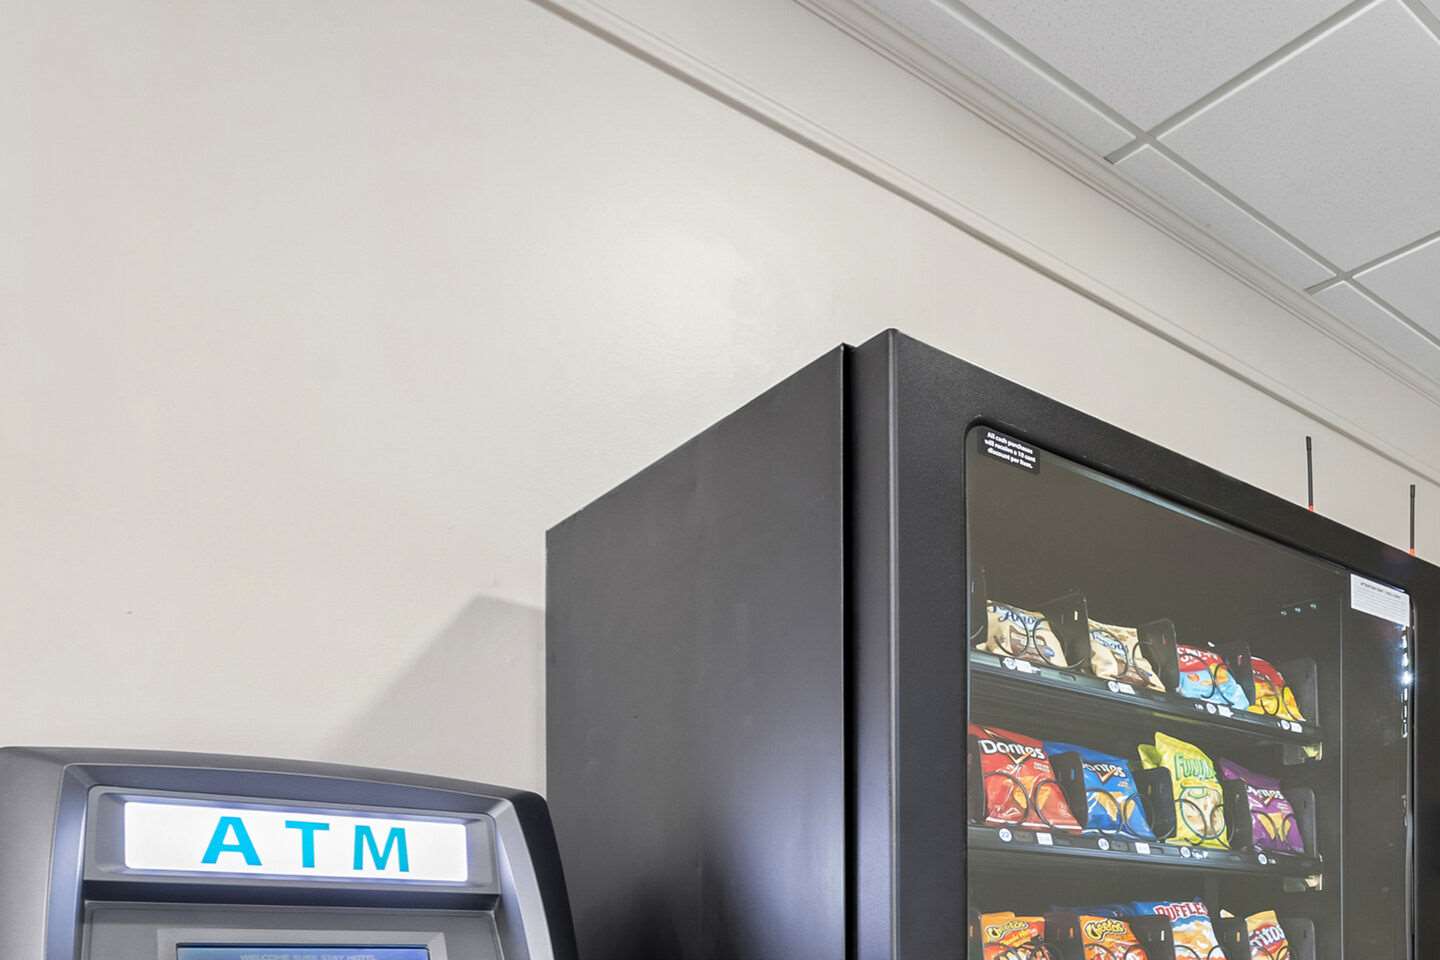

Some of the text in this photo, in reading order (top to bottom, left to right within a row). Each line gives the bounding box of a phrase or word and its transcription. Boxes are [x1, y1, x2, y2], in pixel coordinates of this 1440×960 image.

[979, 738, 1047, 760] Doritos
[1082, 761, 1127, 778] oritos
[201, 815, 410, 873] ATM
